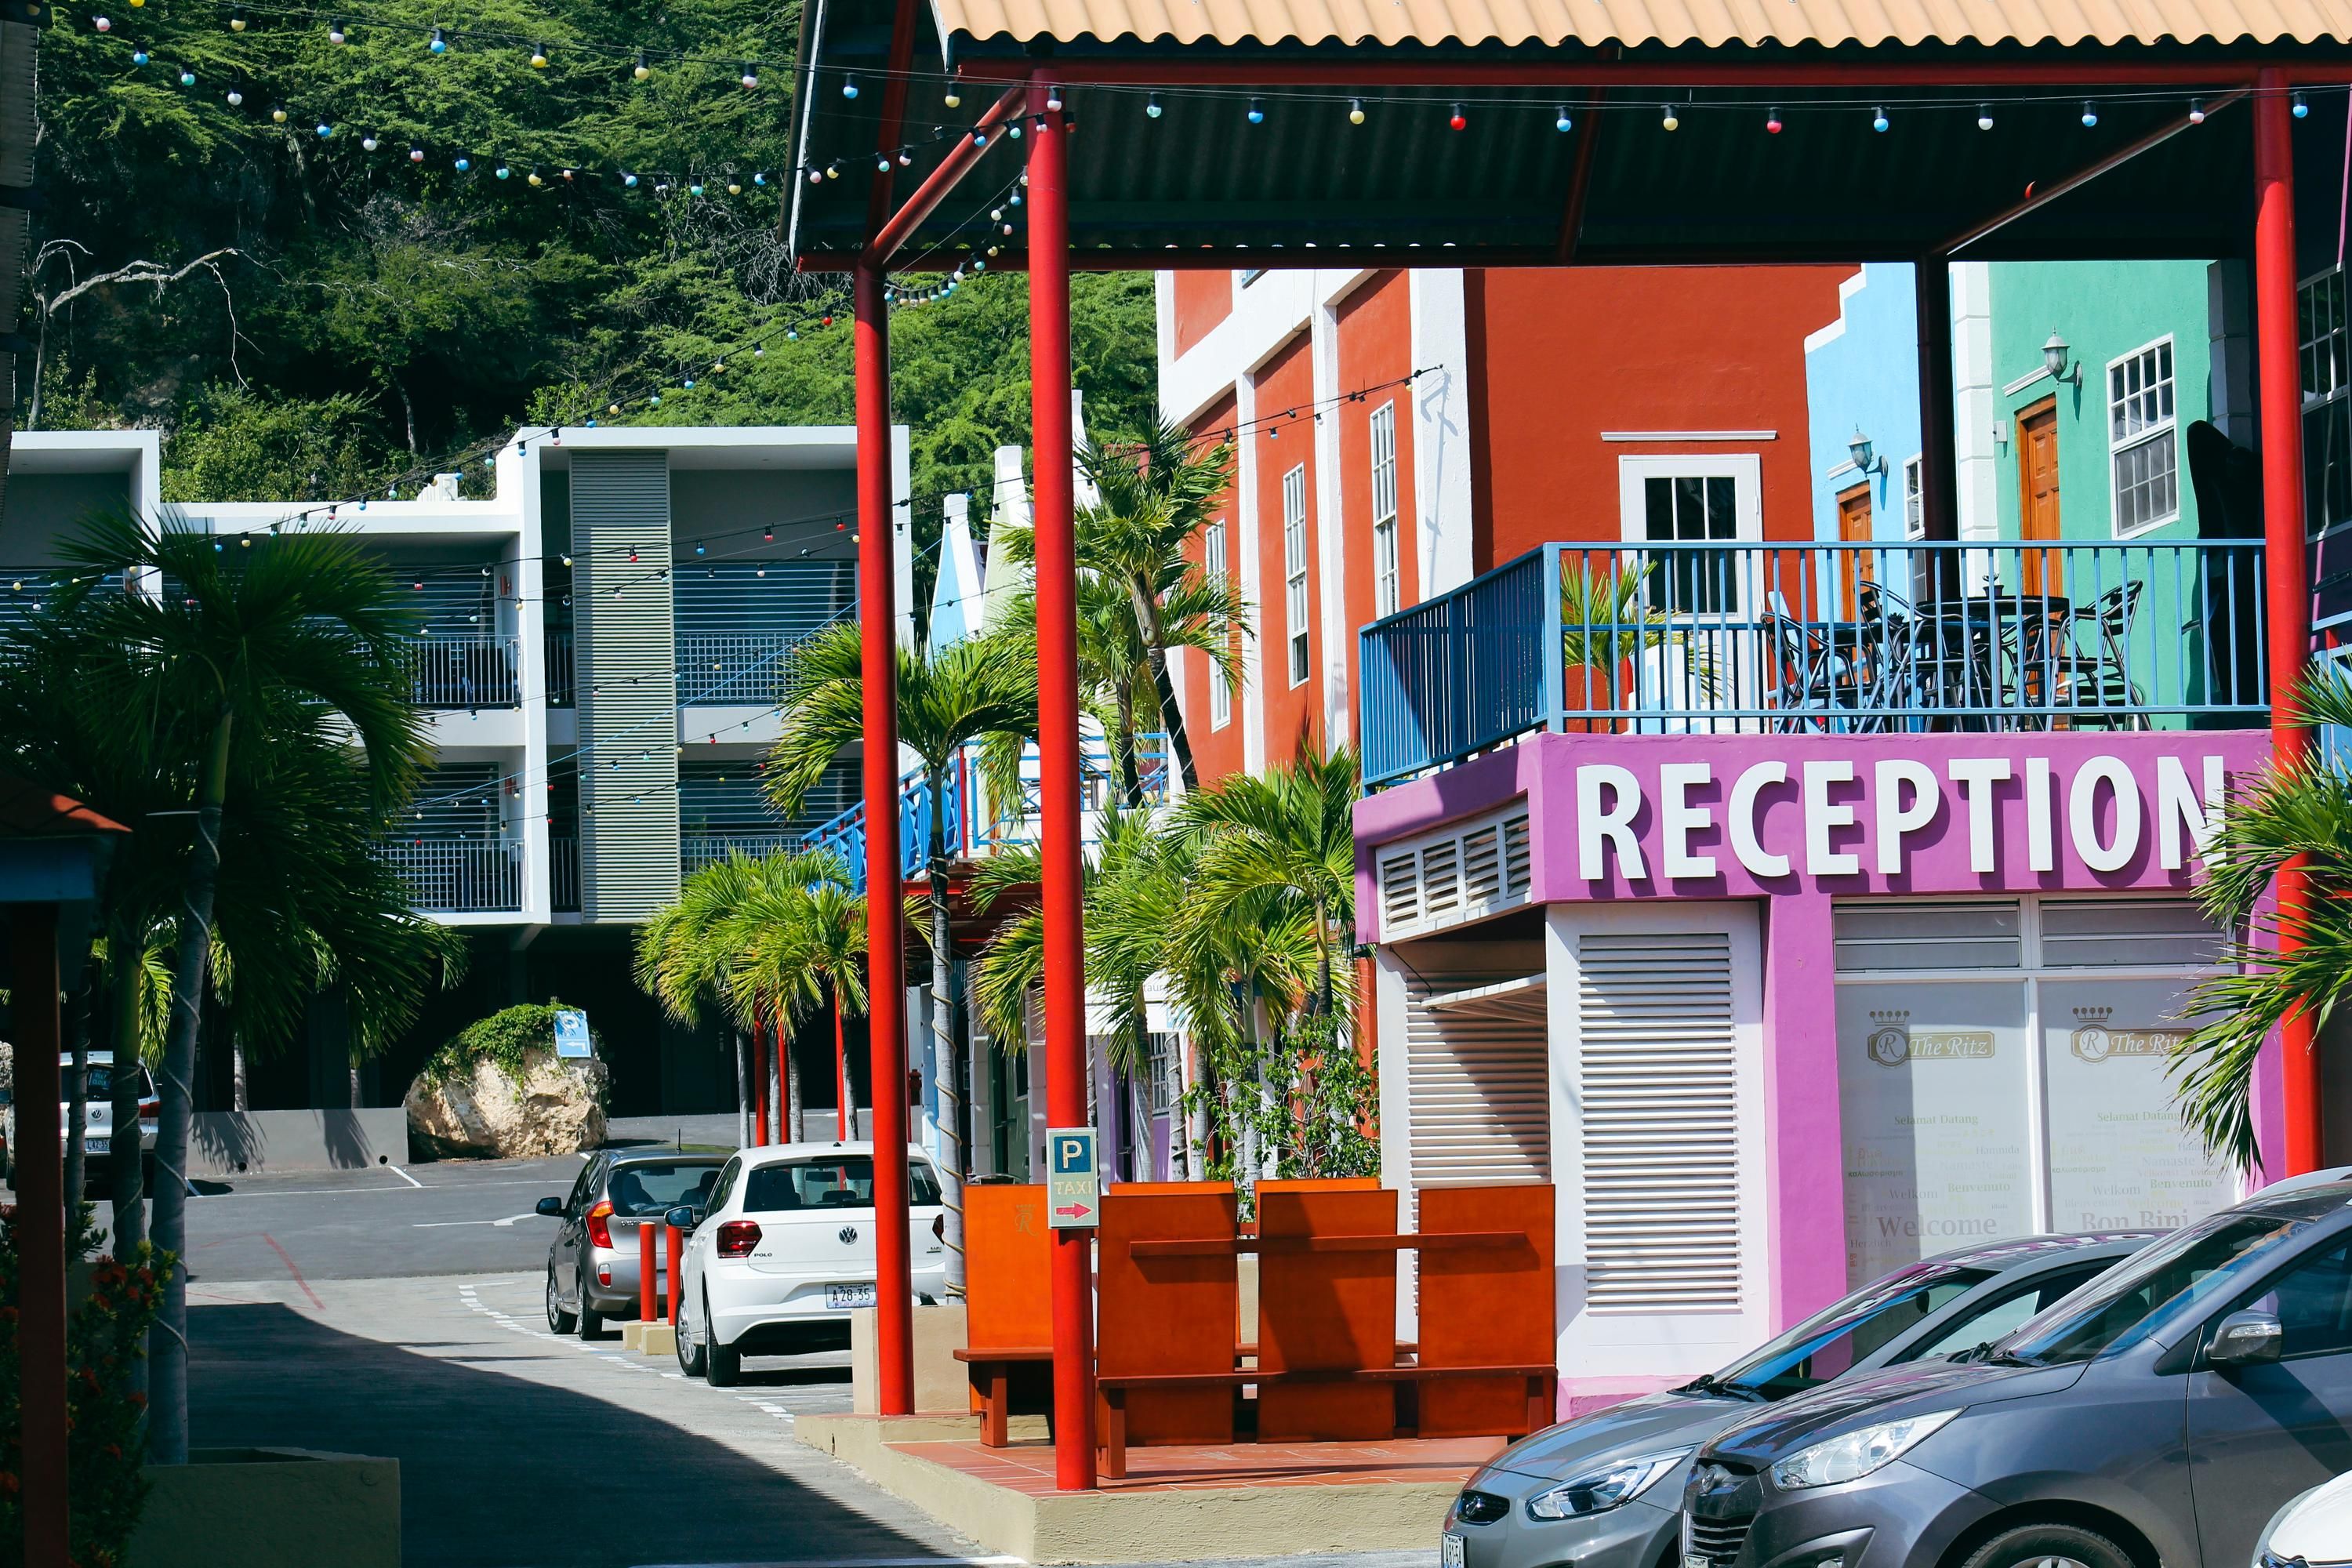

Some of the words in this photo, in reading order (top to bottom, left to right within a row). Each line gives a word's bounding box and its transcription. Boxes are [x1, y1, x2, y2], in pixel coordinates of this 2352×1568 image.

[1577, 755, 2227, 880] RECEPTION
[1909, 1036, 1941, 1056] The
[1947, 1036, 1988, 1058] Ritz
[2111, 1033, 2145, 1053] The
[1894, 1114, 1936, 1125] Selamat
[1940, 1114, 1979, 1126] Datang
[2097, 1112, 2139, 1123] Selamat
[2143, 1111, 2180, 1123] Datang
[1062, 1140, 1083, 1169] P
[2142, 1156, 2195, 1167] Namaste
[1054, 1180, 1093, 1196] TAXI
[1889, 1188, 1938, 1199] Welkom
[1947, 1181, 2011, 1193] Benvenuto
[2092, 1185, 2140, 1196] Welkom
[2151, 1178, 2212, 1190] Benvenuto
[1876, 1214, 1997, 1237] Welcome
[2082, 1212, 2129, 1230] Bon
[2139, 1208, 2188, 1228] Bini
[1850, 1238, 1892, 1249] Herzlich
